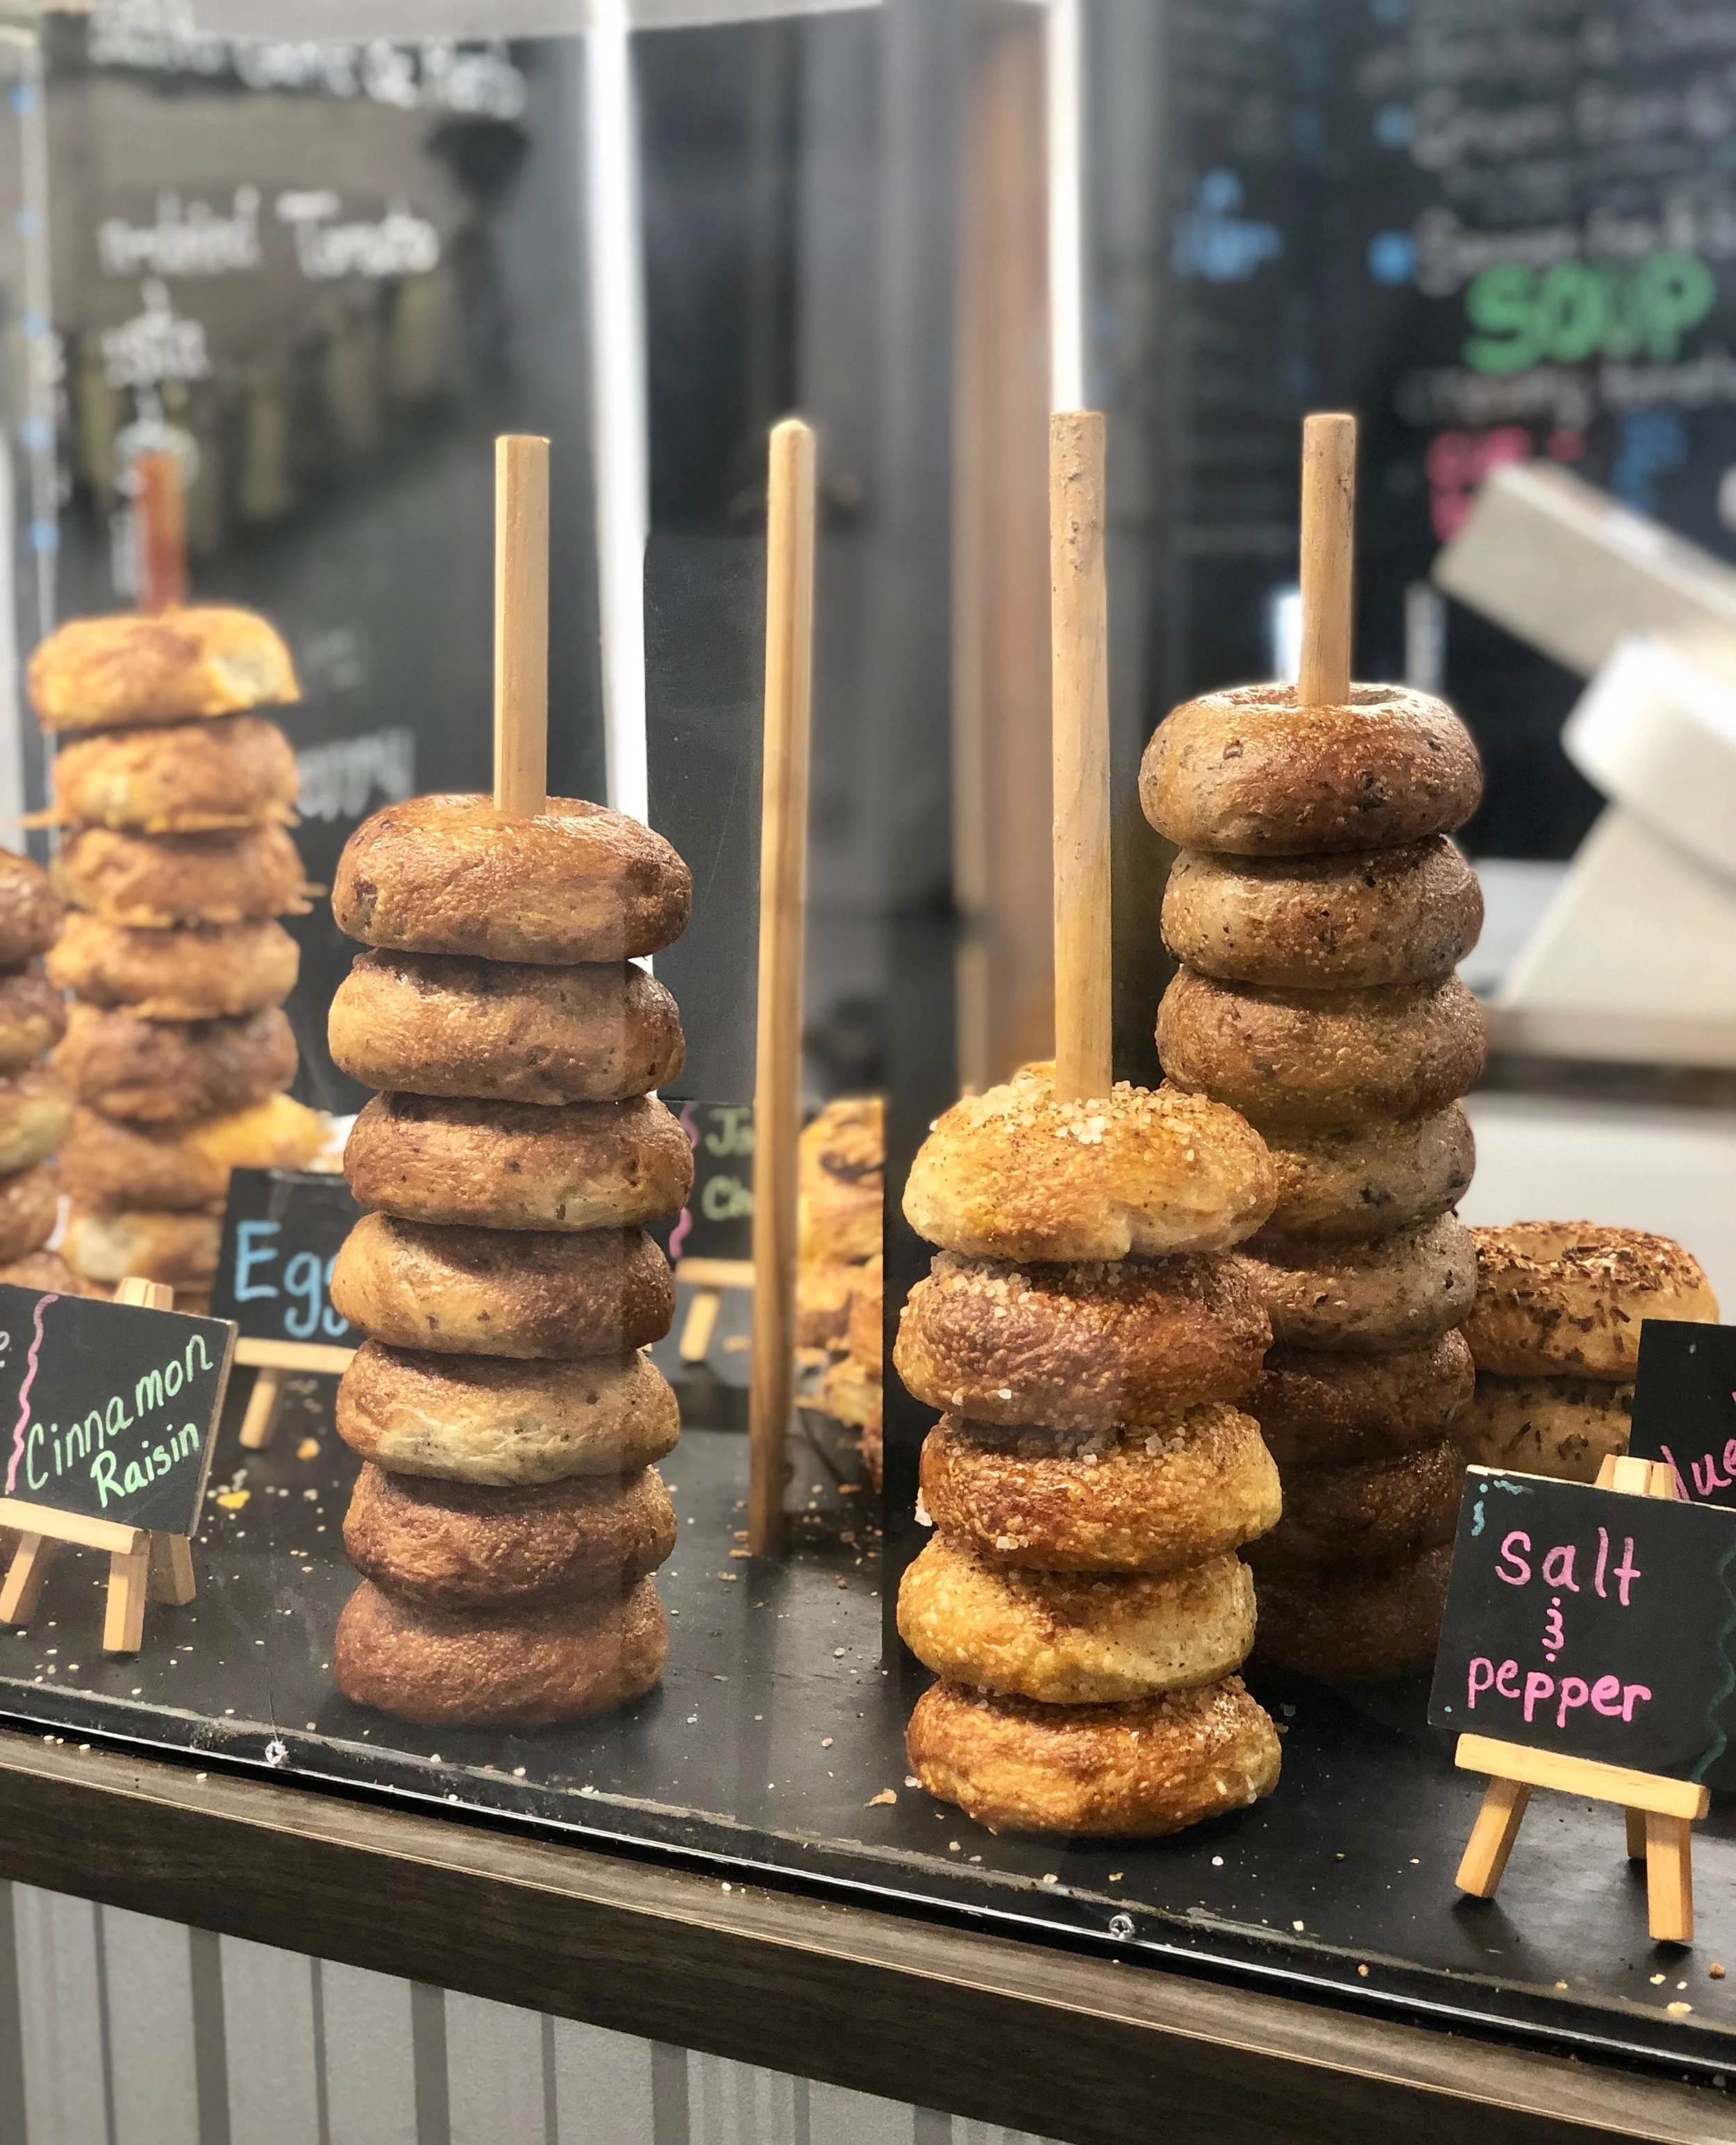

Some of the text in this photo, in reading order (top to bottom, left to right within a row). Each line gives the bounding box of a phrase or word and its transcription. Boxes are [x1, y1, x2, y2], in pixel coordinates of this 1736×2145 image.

[1462, 251, 1715, 374] SOUP
[26, 1335, 213, 1489] Cinnamon
[90, 1421, 200, 1508] Raisin
[1494, 1526, 1642, 1606] Salt
[1467, 1657, 1653, 1728] pepper
